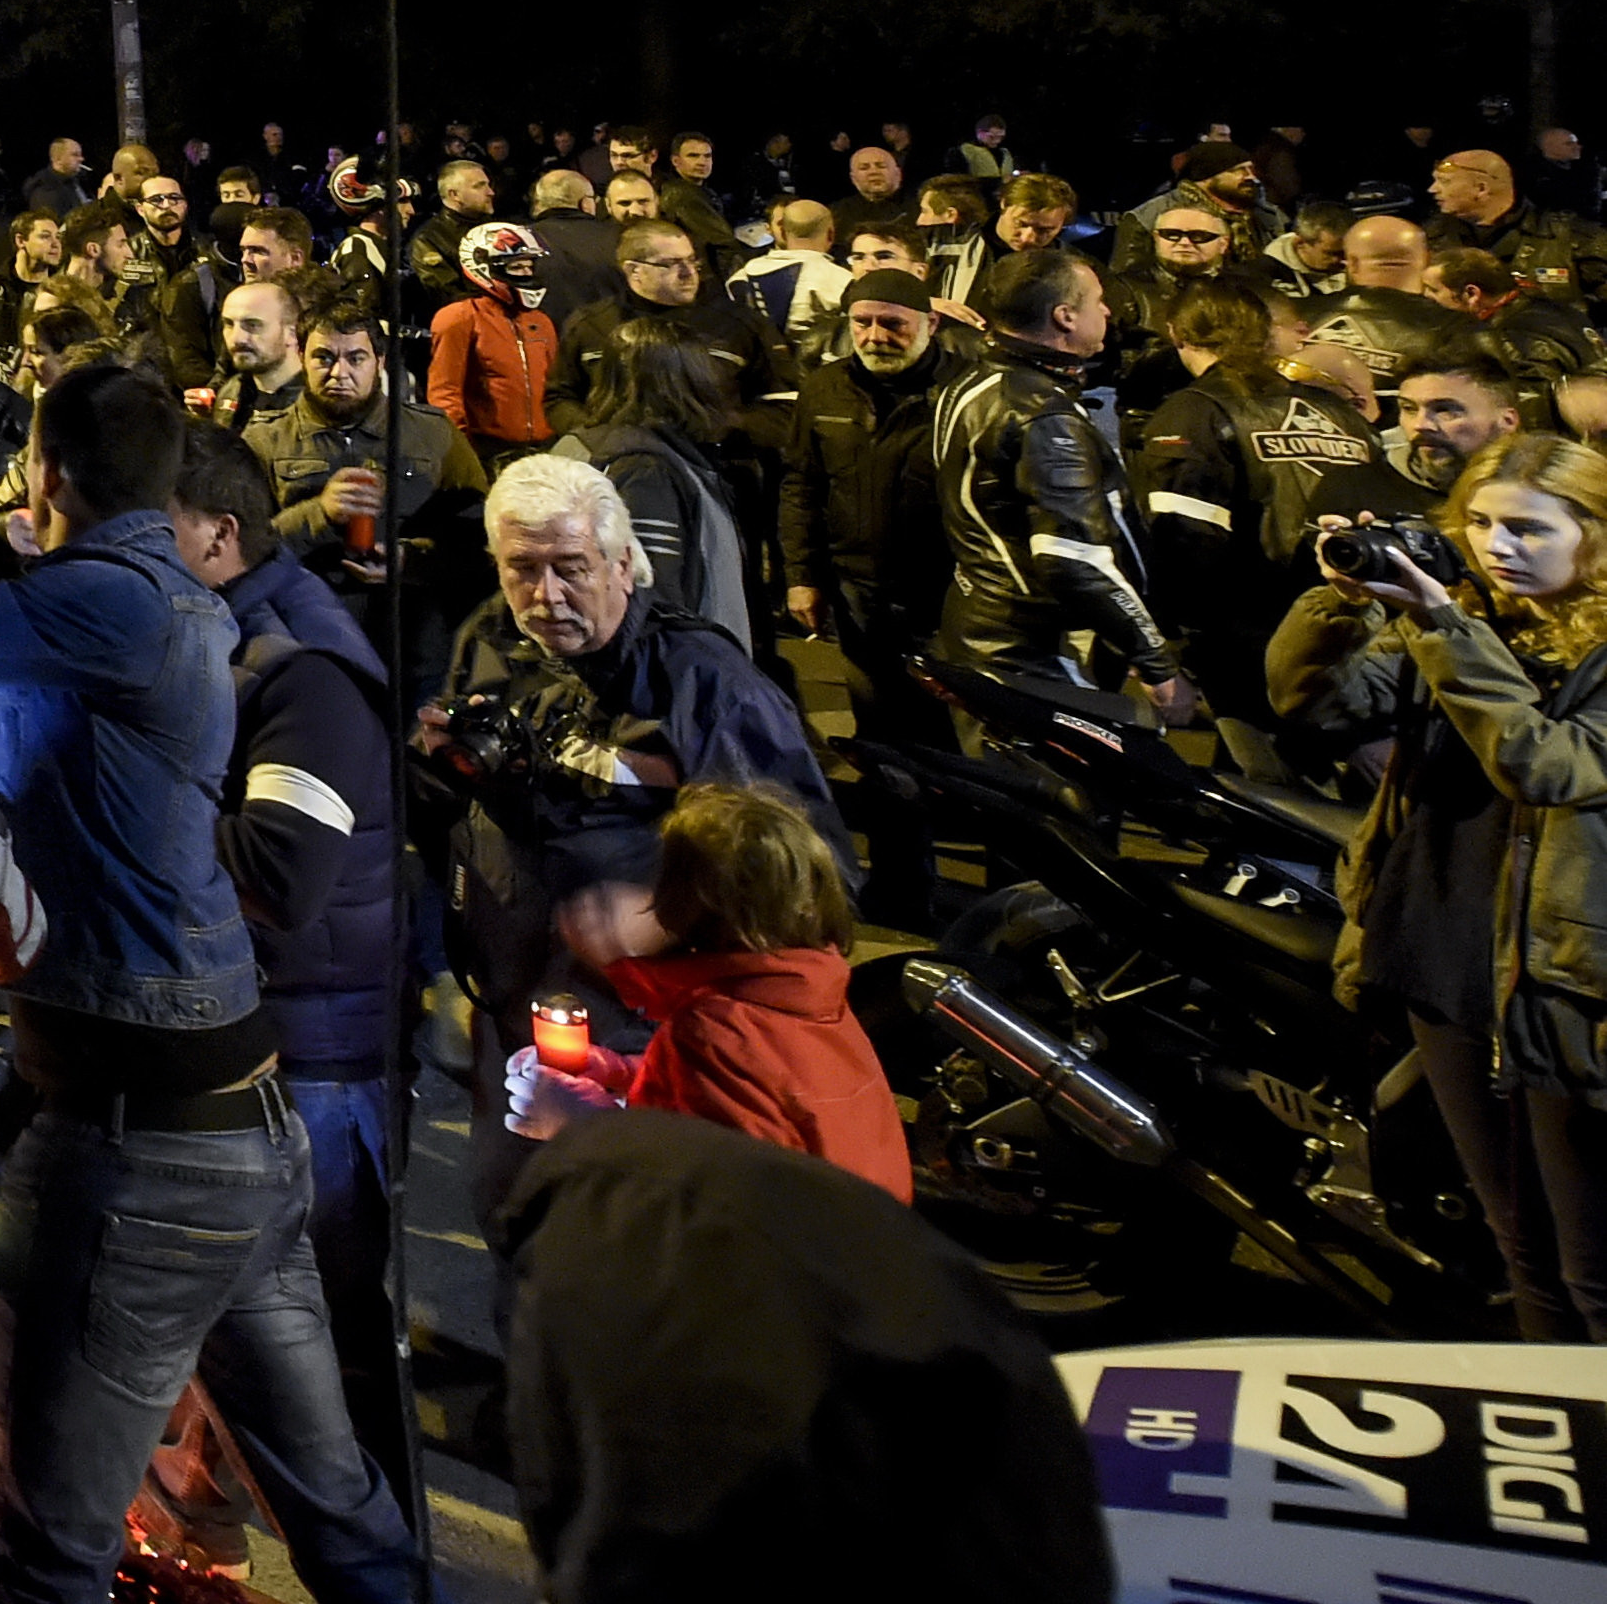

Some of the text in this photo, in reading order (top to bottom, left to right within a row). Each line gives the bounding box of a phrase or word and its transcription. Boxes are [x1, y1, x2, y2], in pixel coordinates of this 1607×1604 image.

[1123, 1406, 1199, 1453] HD
[1169, 1384, 1446, 1519] 24
[1478, 1401, 1590, 1544] DIGI
